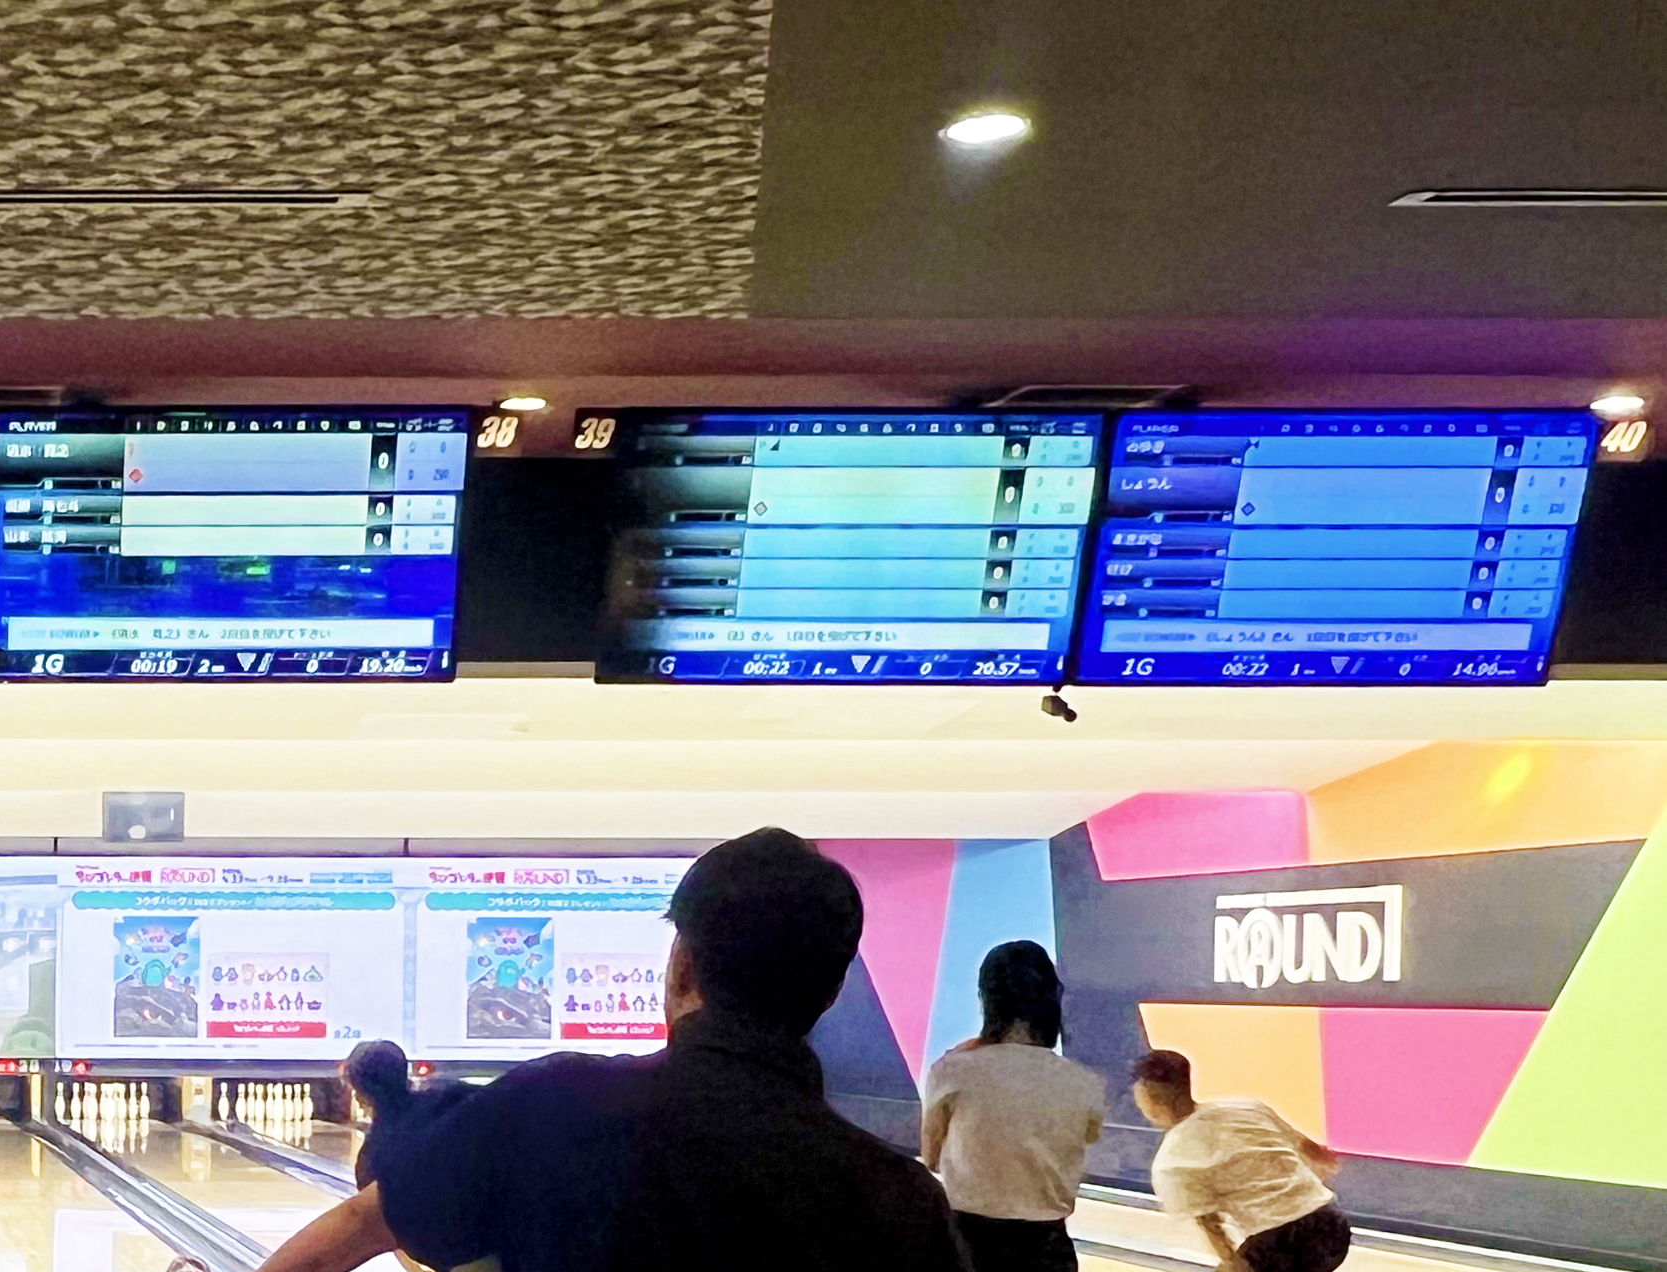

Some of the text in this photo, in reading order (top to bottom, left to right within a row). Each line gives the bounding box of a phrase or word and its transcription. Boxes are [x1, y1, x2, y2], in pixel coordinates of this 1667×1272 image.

[476, 416, 519, 448] 38
[574, 418, 616, 450] 39
[1600, 420, 1648, 453] 40
[31, 654, 65, 674] 1G
[1121, 658, 1156, 676] 1G
